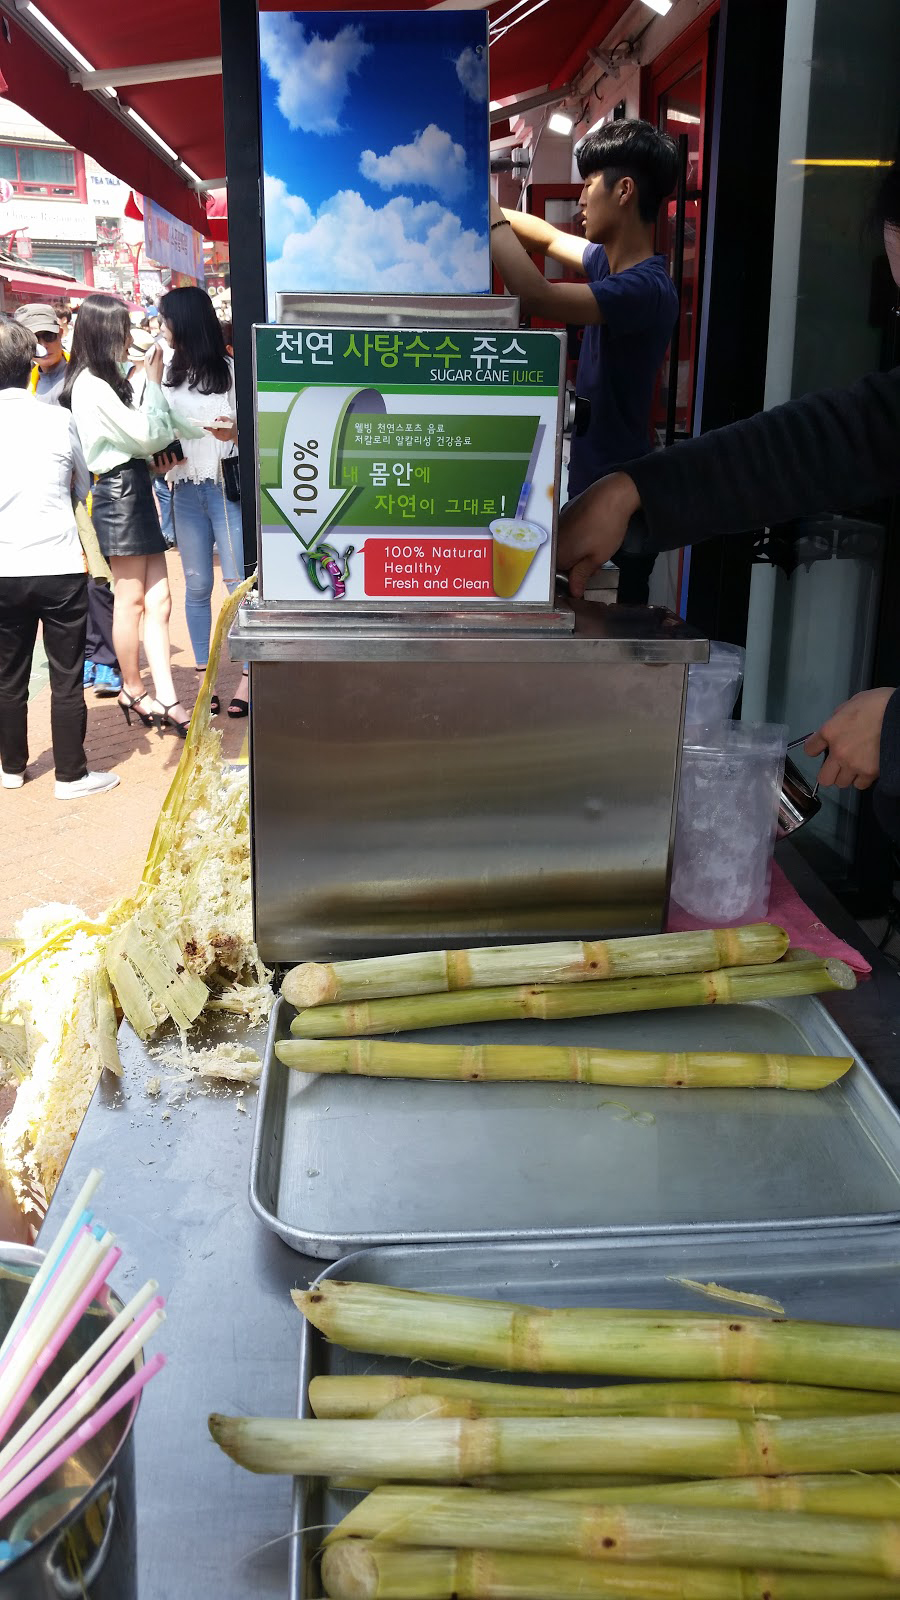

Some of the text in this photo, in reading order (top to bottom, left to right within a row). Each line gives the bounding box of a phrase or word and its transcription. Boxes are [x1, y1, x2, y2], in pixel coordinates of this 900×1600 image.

[275, 331, 528, 369] 천연 사탕수수 쥬스
[430, 369, 543, 385] SUGAR CANE JUICE
[355, 423, 445, 433] 웰빙 천연스포츠 음료
[355, 435, 472, 446] 저칼로리 알칼리성 건강음료
[293, 439, 319, 516] 100%
[343, 462, 430, 487] 내 몸안에
[375, 495, 506, 517] 자연이 그대로!
[384, 546, 487, 558] 100% Natural
[384, 562, 441, 576] Healthy
[384, 578, 490, 589] Fresh and Clean
